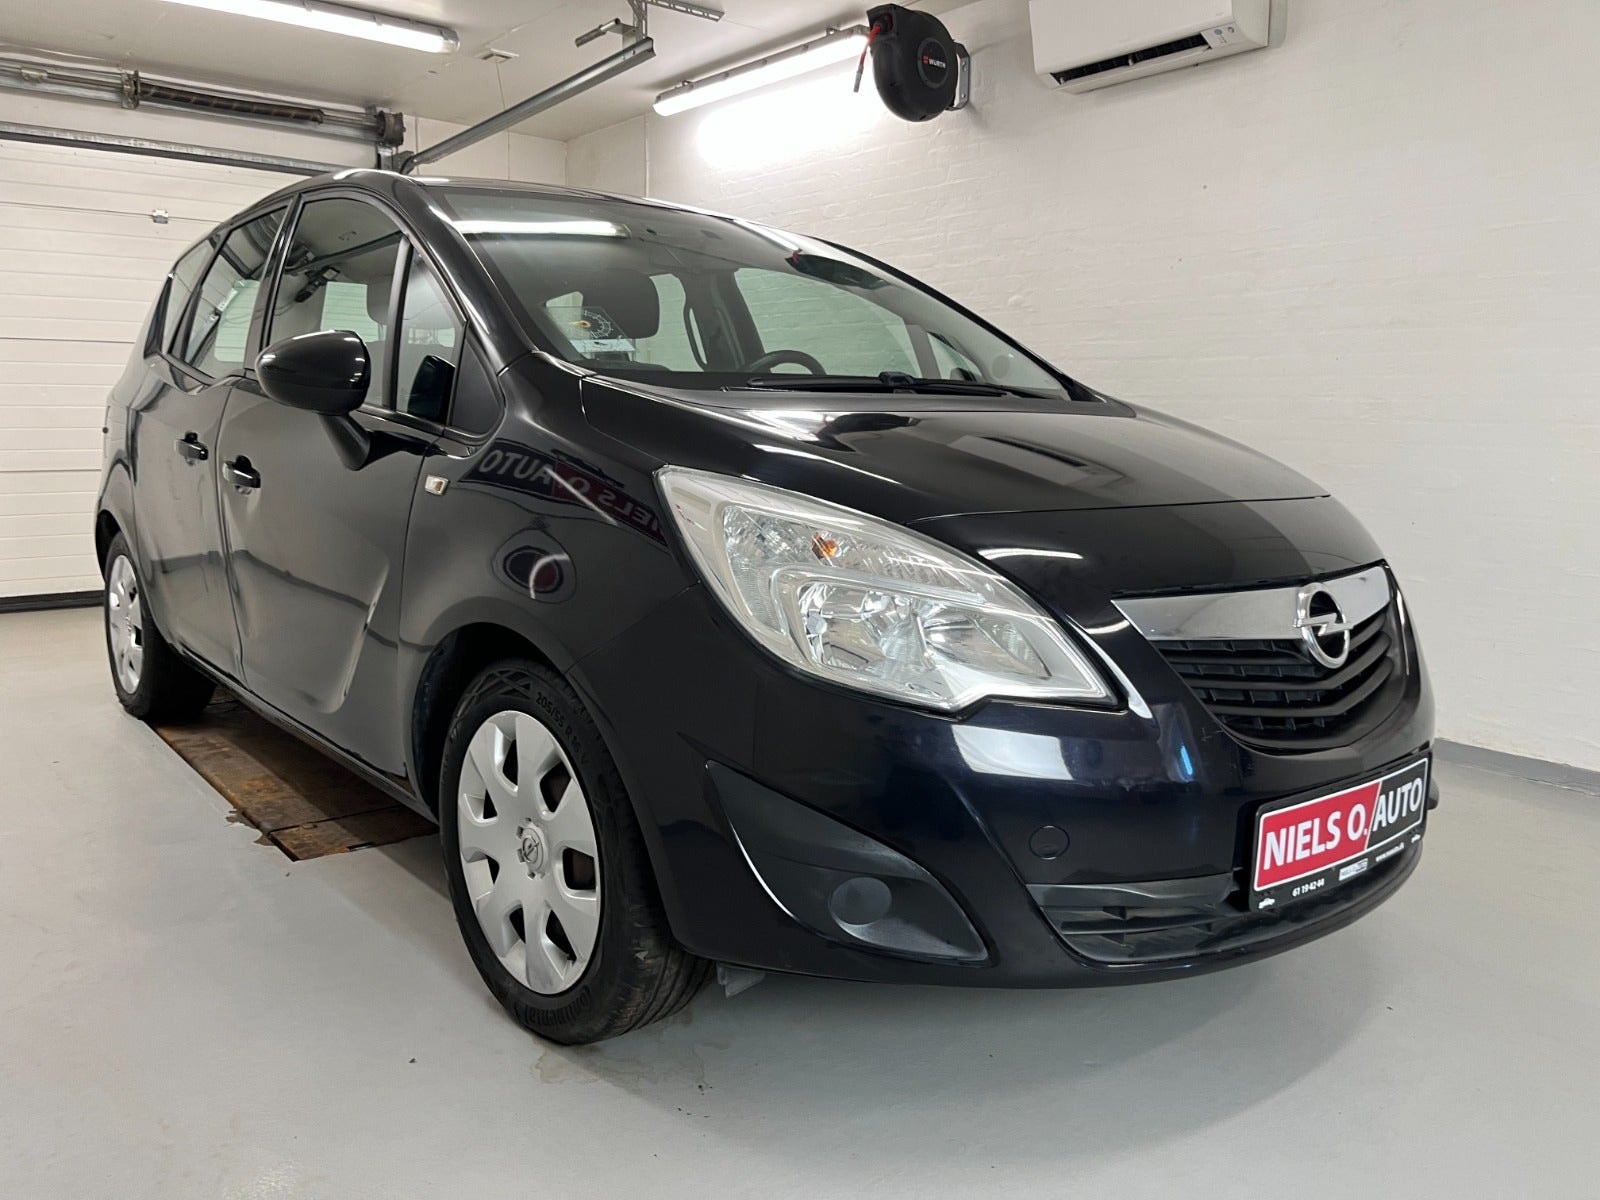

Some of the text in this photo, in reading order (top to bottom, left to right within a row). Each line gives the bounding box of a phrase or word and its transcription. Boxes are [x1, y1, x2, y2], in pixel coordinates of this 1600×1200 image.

[1263, 777, 1423, 870] NIELS O. AUTO
